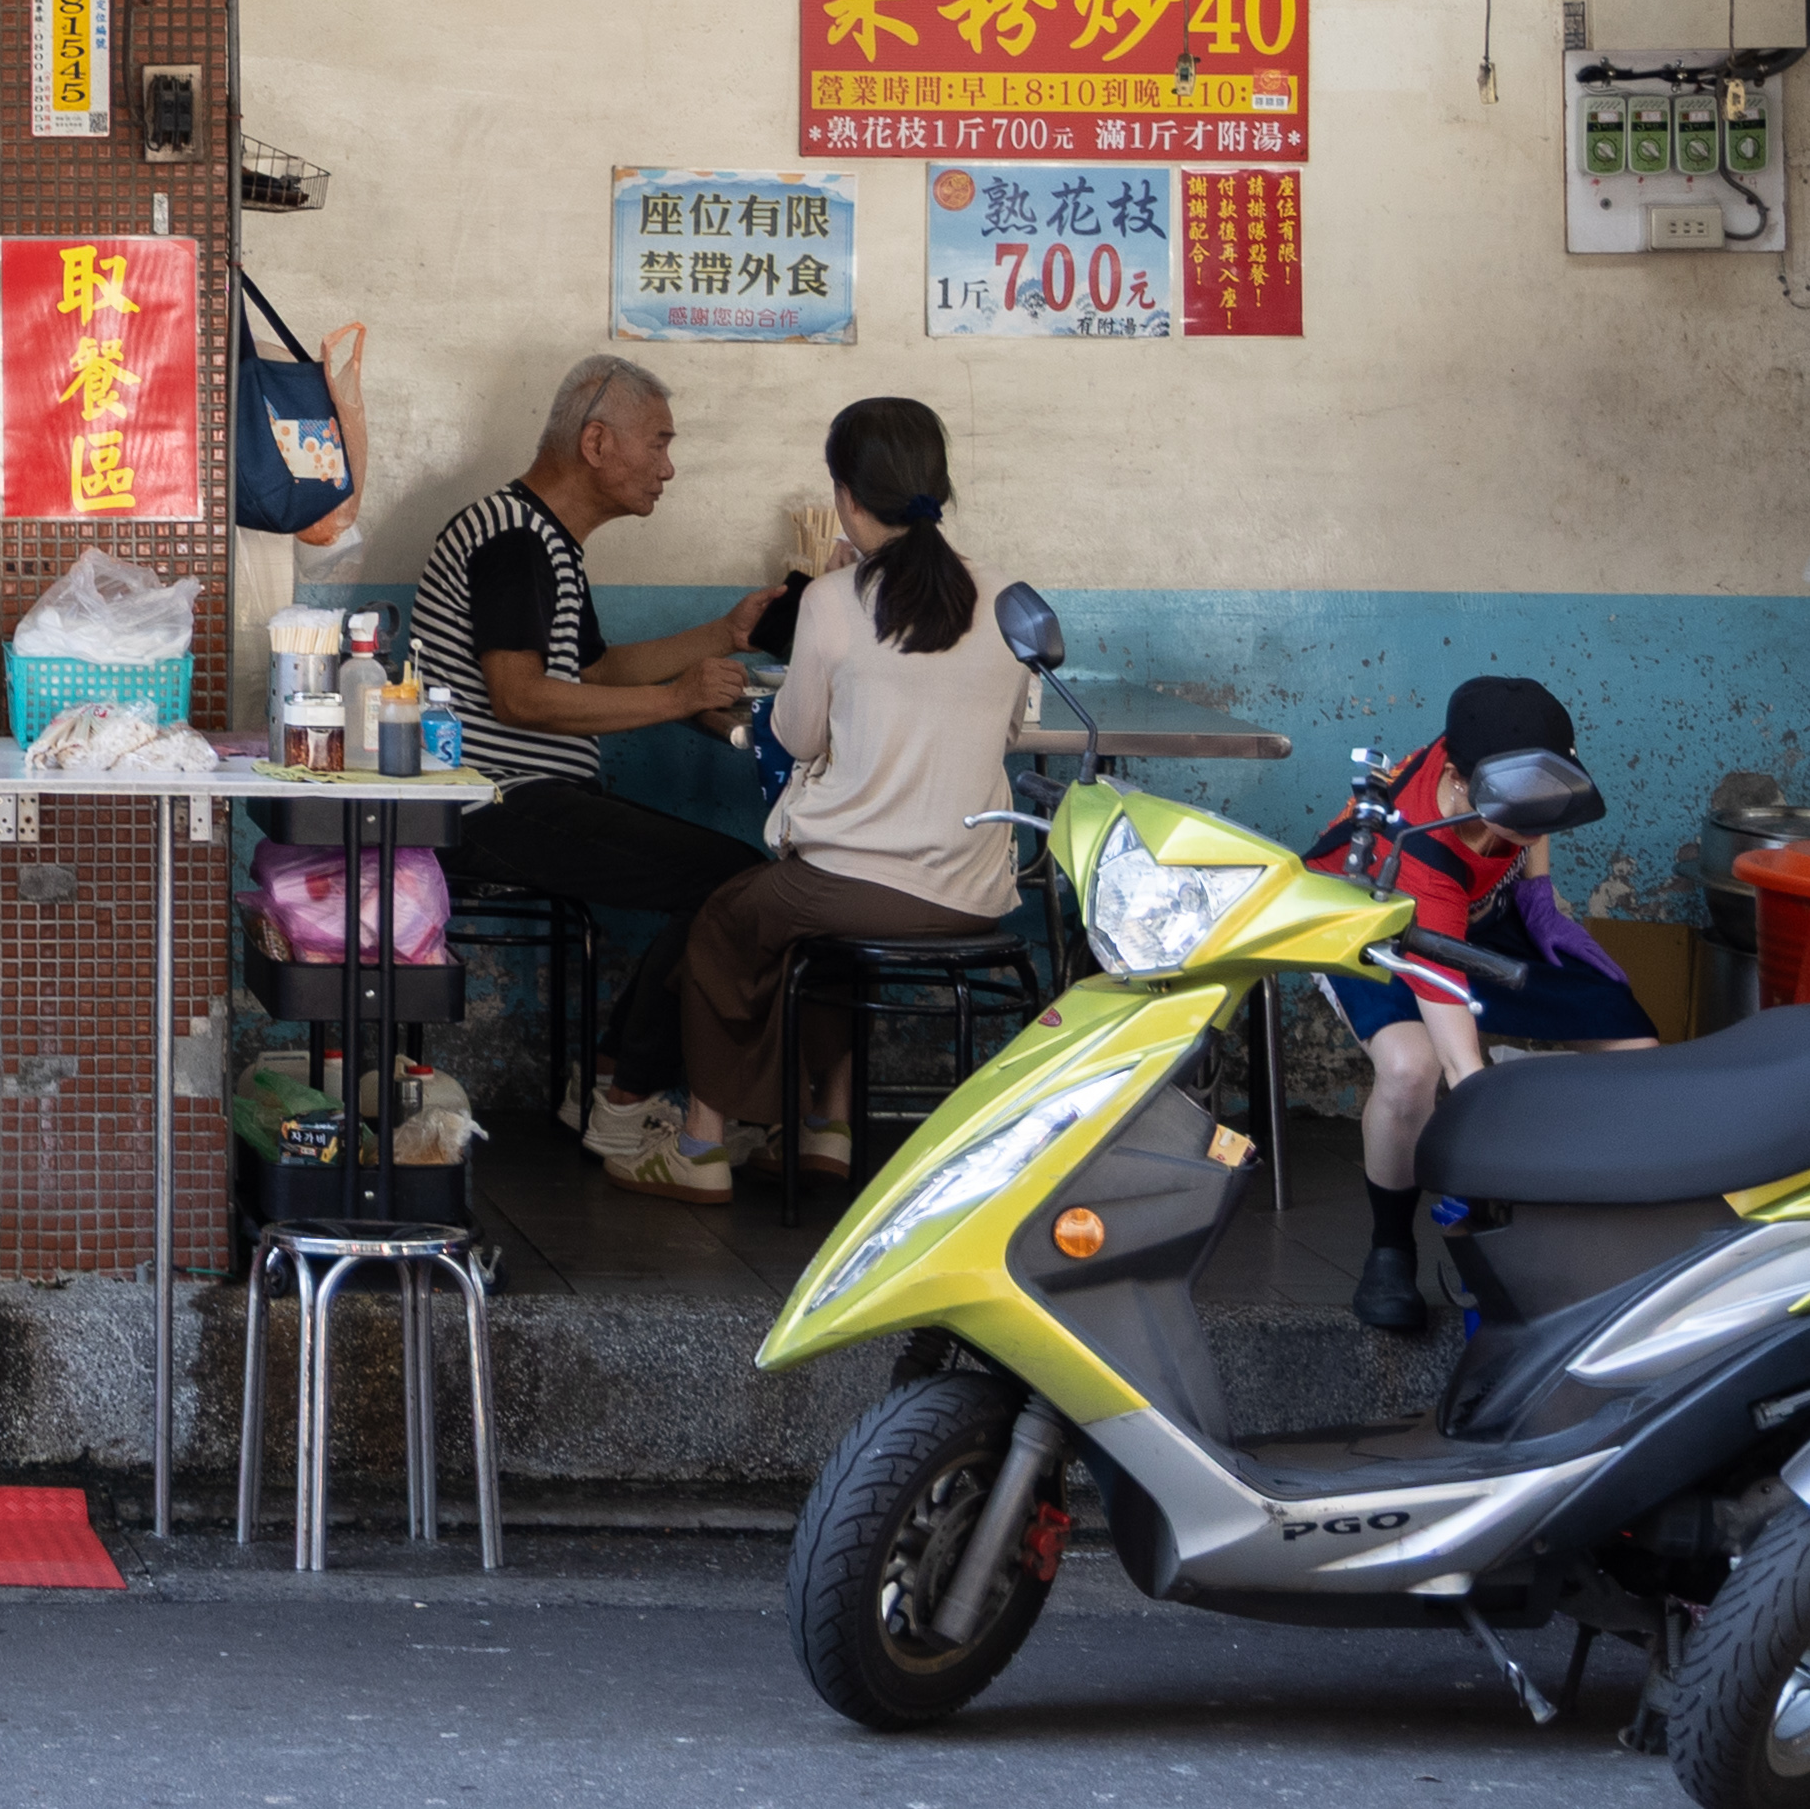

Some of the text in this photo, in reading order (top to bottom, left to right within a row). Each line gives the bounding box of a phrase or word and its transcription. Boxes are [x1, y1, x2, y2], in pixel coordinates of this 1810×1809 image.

[640, 192, 830, 238] 座位有限
[981, 176, 1167, 240] 熟花枝
[640, 250, 830, 297] 禁帶外食
[668, 306, 799, 328] 感謝您的合作
[57, 244, 141, 513] 取餐區
[1283, 1510, 1411, 1542] PGO
